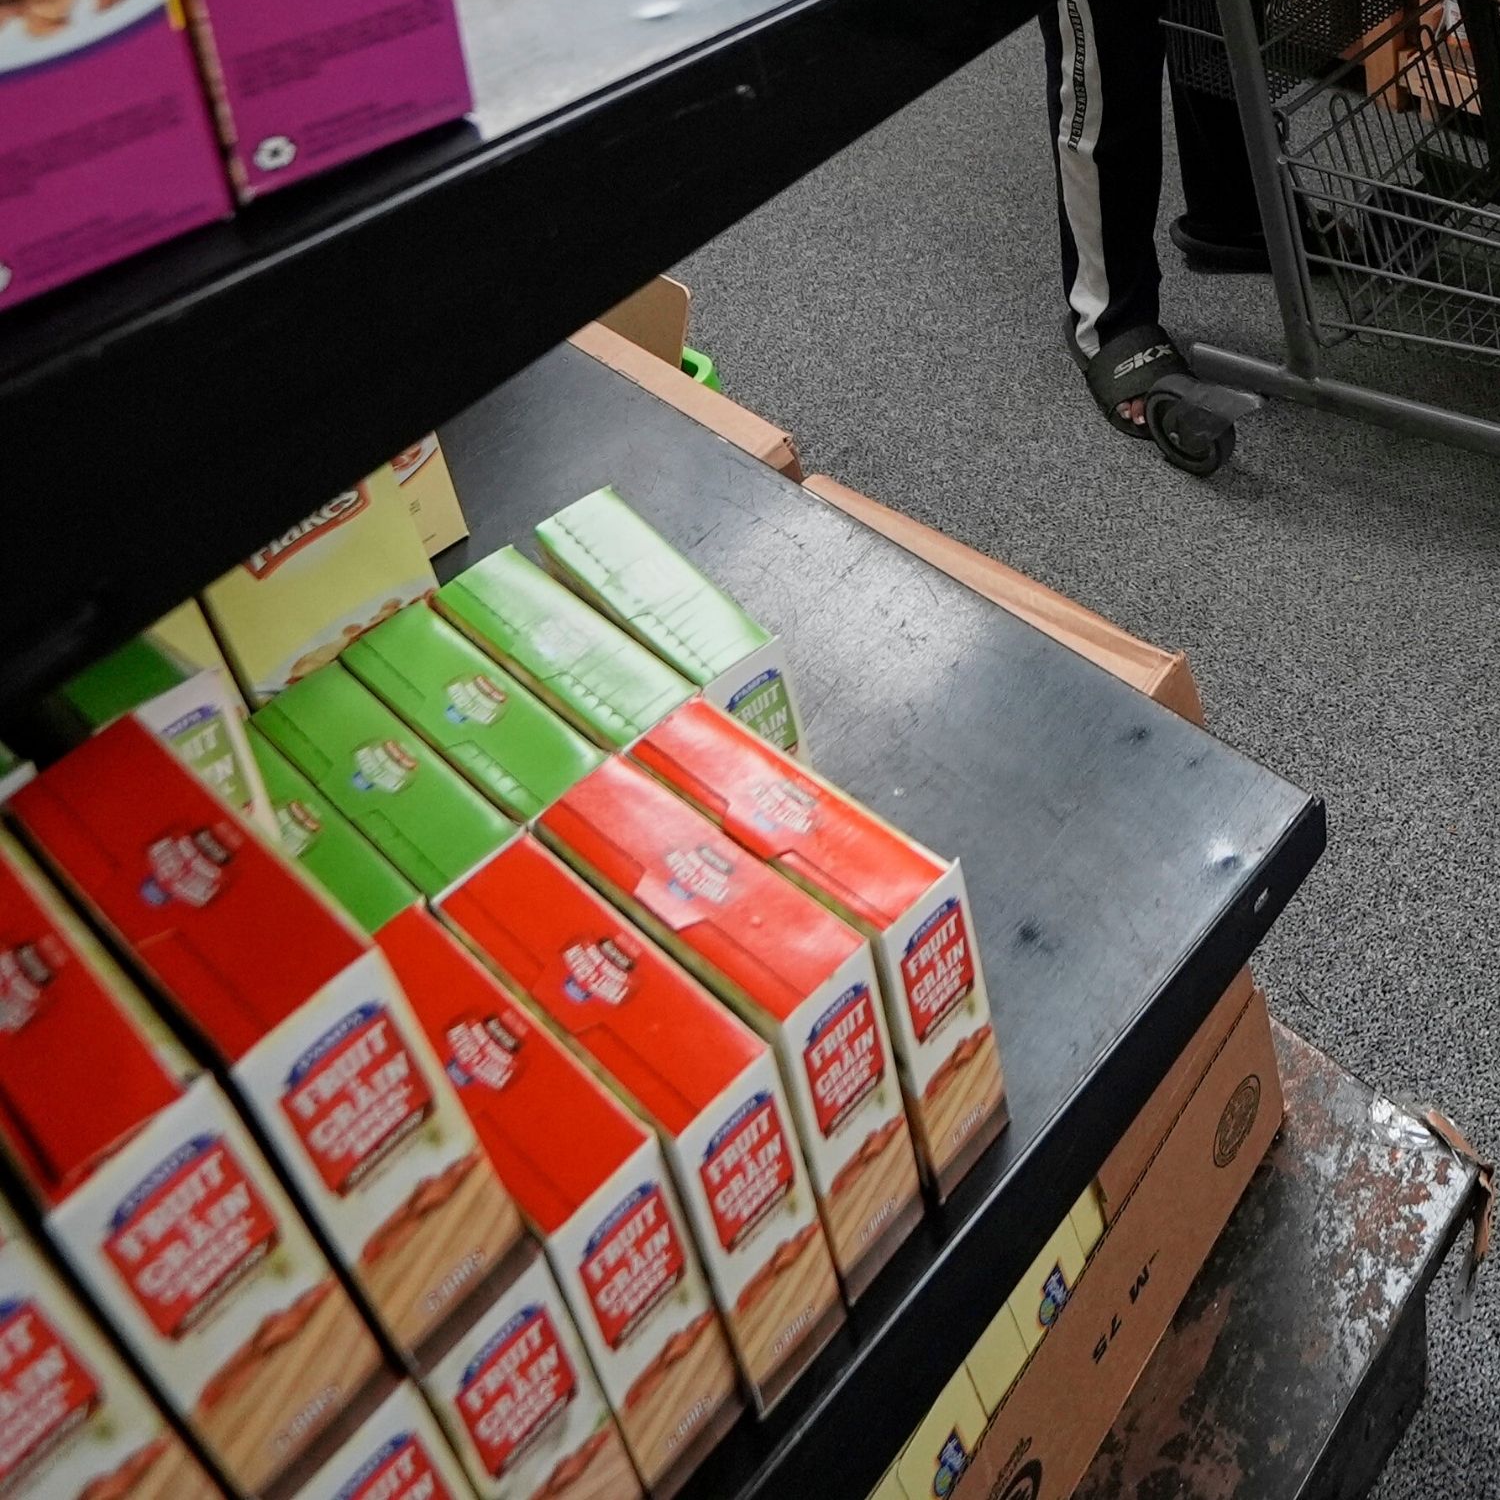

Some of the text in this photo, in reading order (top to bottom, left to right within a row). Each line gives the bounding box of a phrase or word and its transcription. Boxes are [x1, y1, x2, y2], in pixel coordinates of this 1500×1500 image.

[1113, 343, 1174, 380] SKX
[907, 912, 959, 979] FRUIT
[911, 939, 966, 1006] GRAIN
[290, 1019, 388, 1120] FRUIT
[809, 996, 868, 1071] FRUIT
[815, 1024, 875, 1095] GRAIN
[307, 1049, 411, 1152] GRAIN
[706, 1105, 772, 1186] FRUIT
[714, 1132, 782, 1212] GRAIN
[115, 1150, 226, 1261] FRUIT
[137, 1181, 252, 1295] GRAIN
[587, 1196, 659, 1284] FRUIT
[596, 1221, 671, 1310] GRAIN
